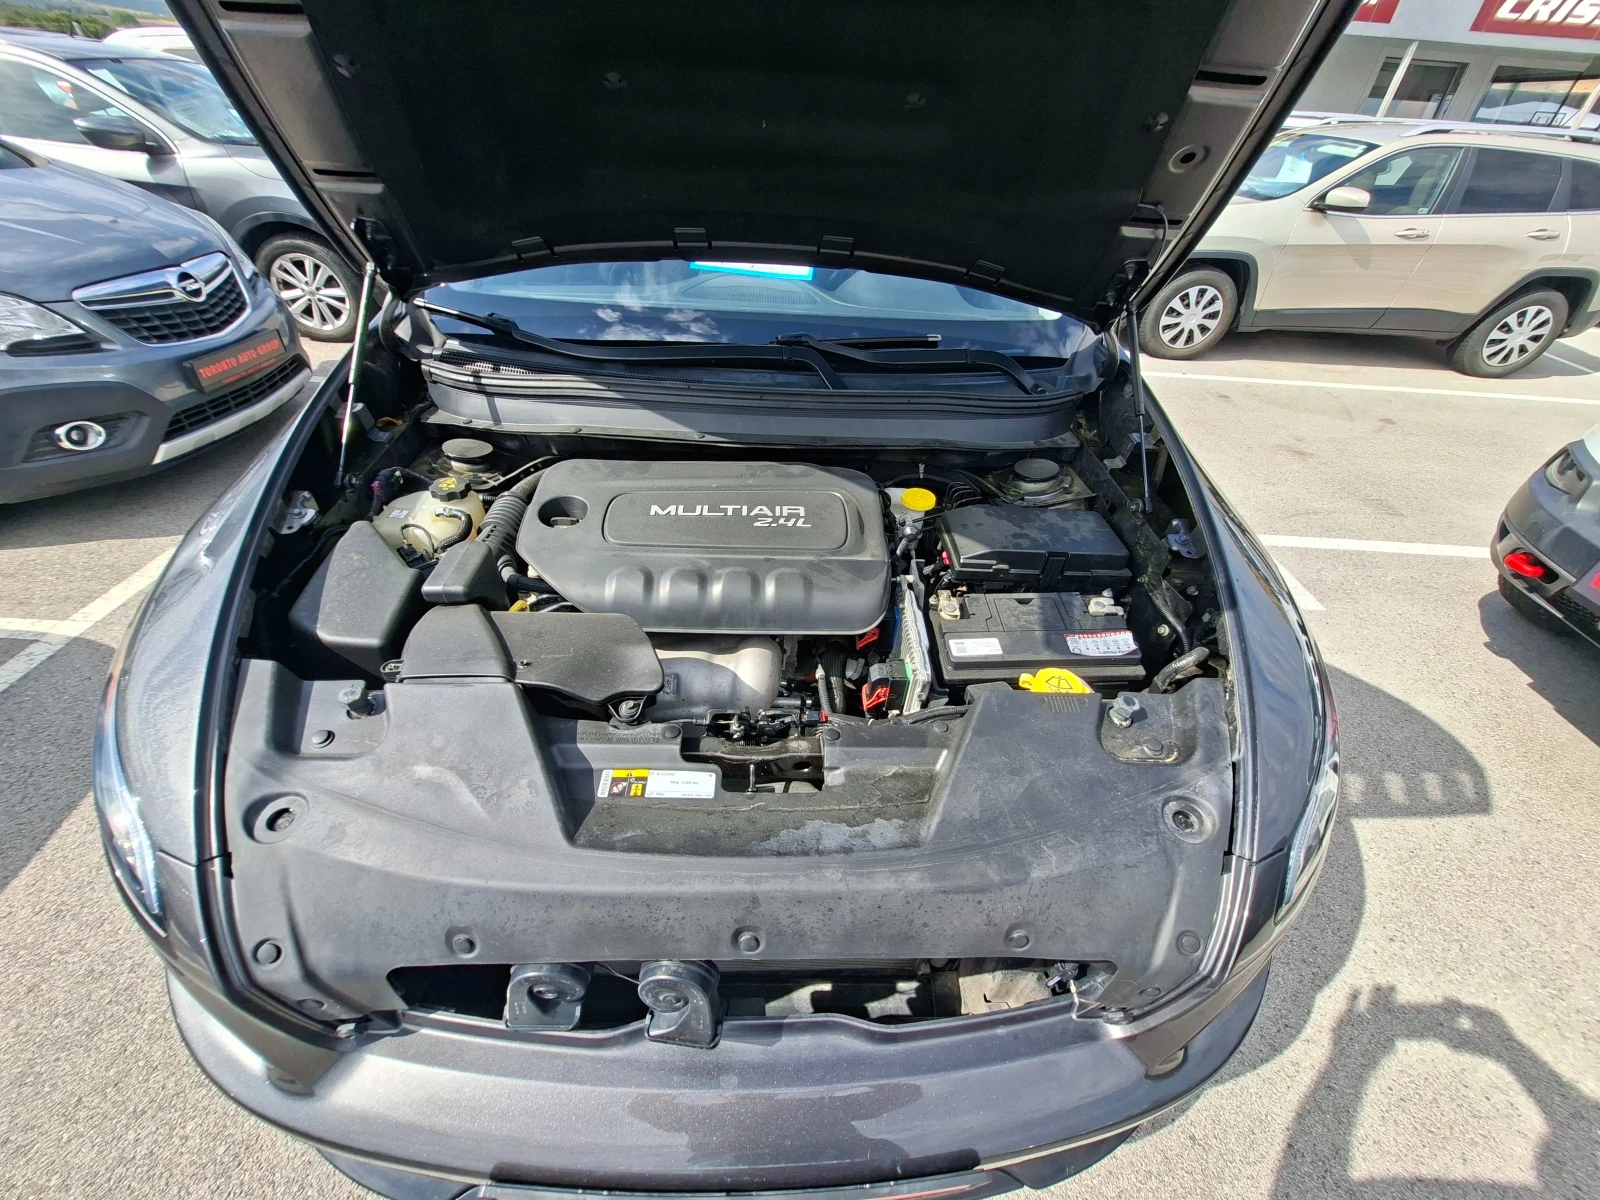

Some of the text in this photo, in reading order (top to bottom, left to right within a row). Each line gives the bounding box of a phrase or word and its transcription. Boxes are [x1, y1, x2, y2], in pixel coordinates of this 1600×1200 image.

[1496, 0, 1600, 25] CRIS
[199, 357, 237, 378] TORONTO
[237, 349, 257, 363] AUTO
[649, 504, 805, 517] MULTIAIR
[753, 517, 812, 527] 2.4L
